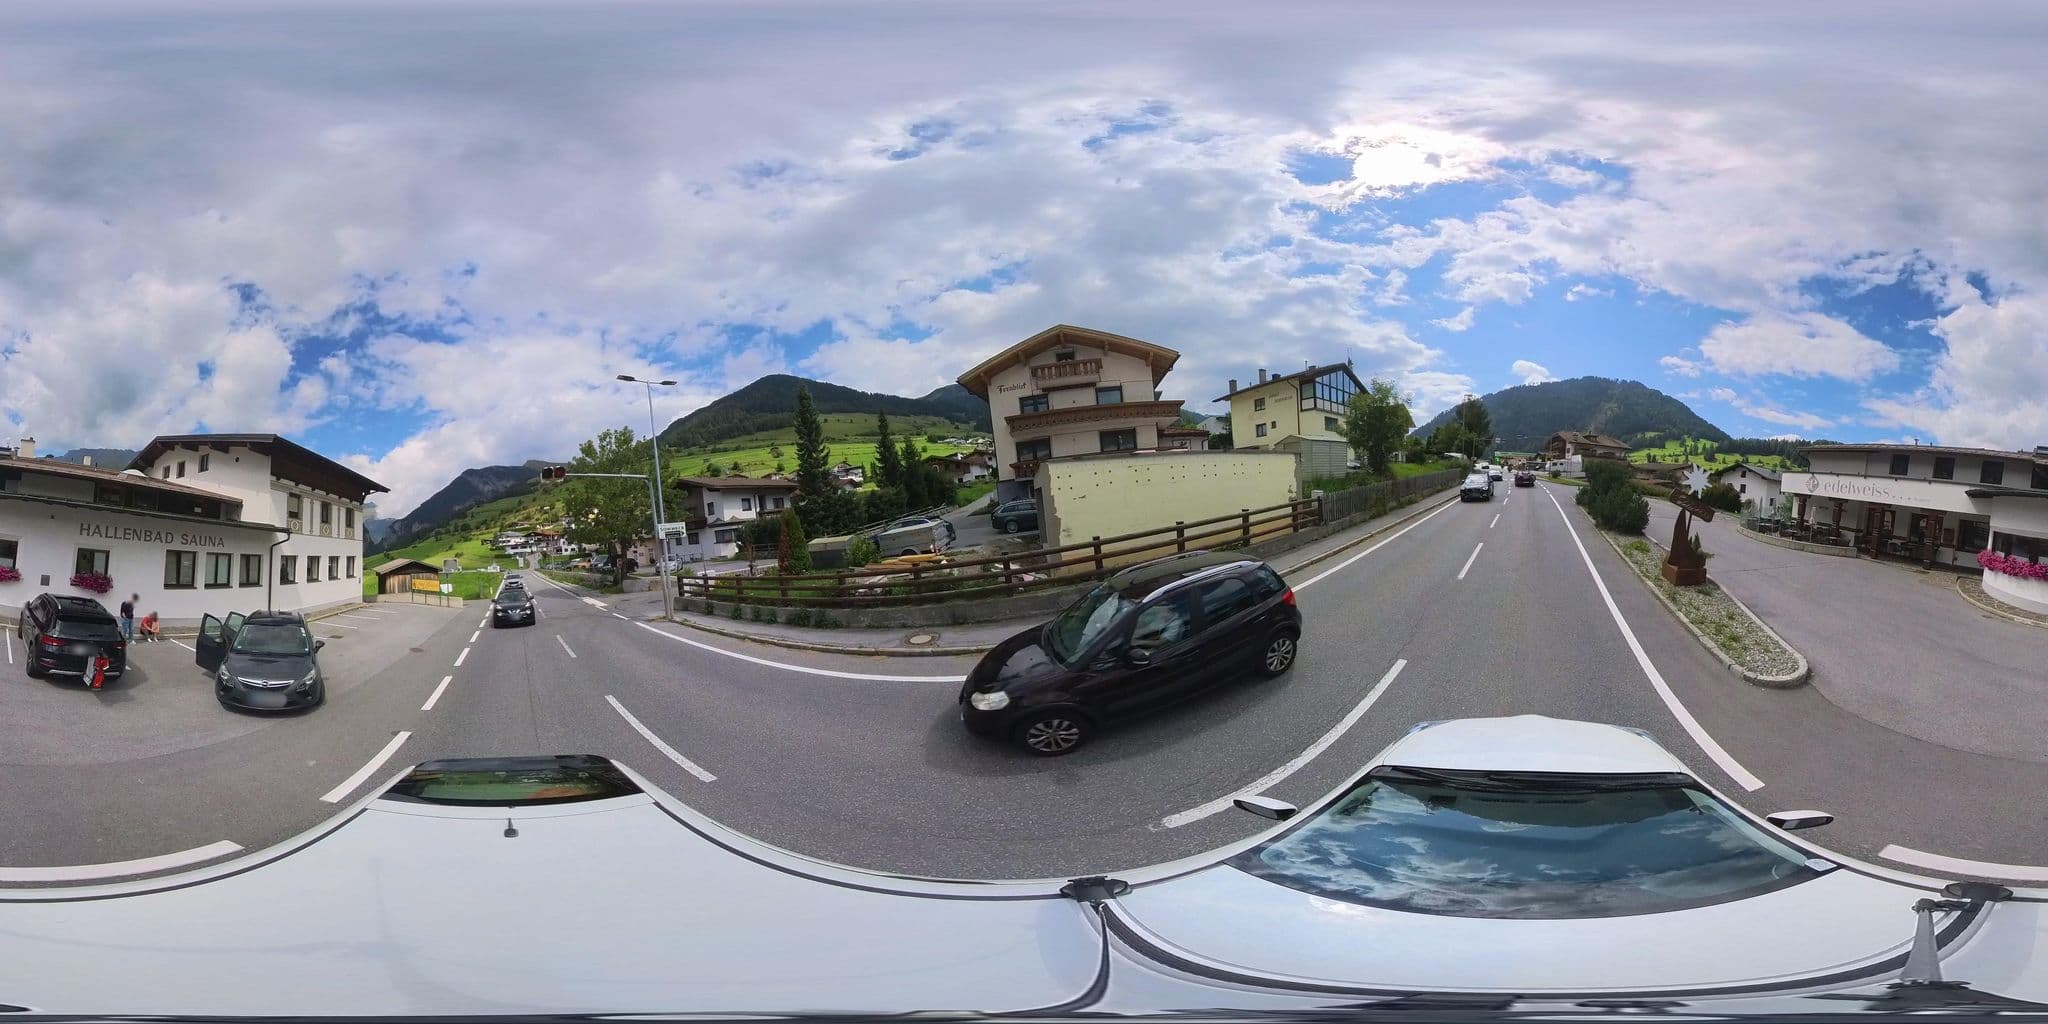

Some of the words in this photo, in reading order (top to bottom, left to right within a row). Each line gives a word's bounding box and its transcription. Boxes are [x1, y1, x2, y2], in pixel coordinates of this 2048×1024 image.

[1824, 480, 1890, 499] edelweiss
[79, 522, 174, 544] HALLENBAD
[180, 533, 225, 548] SAUNA
